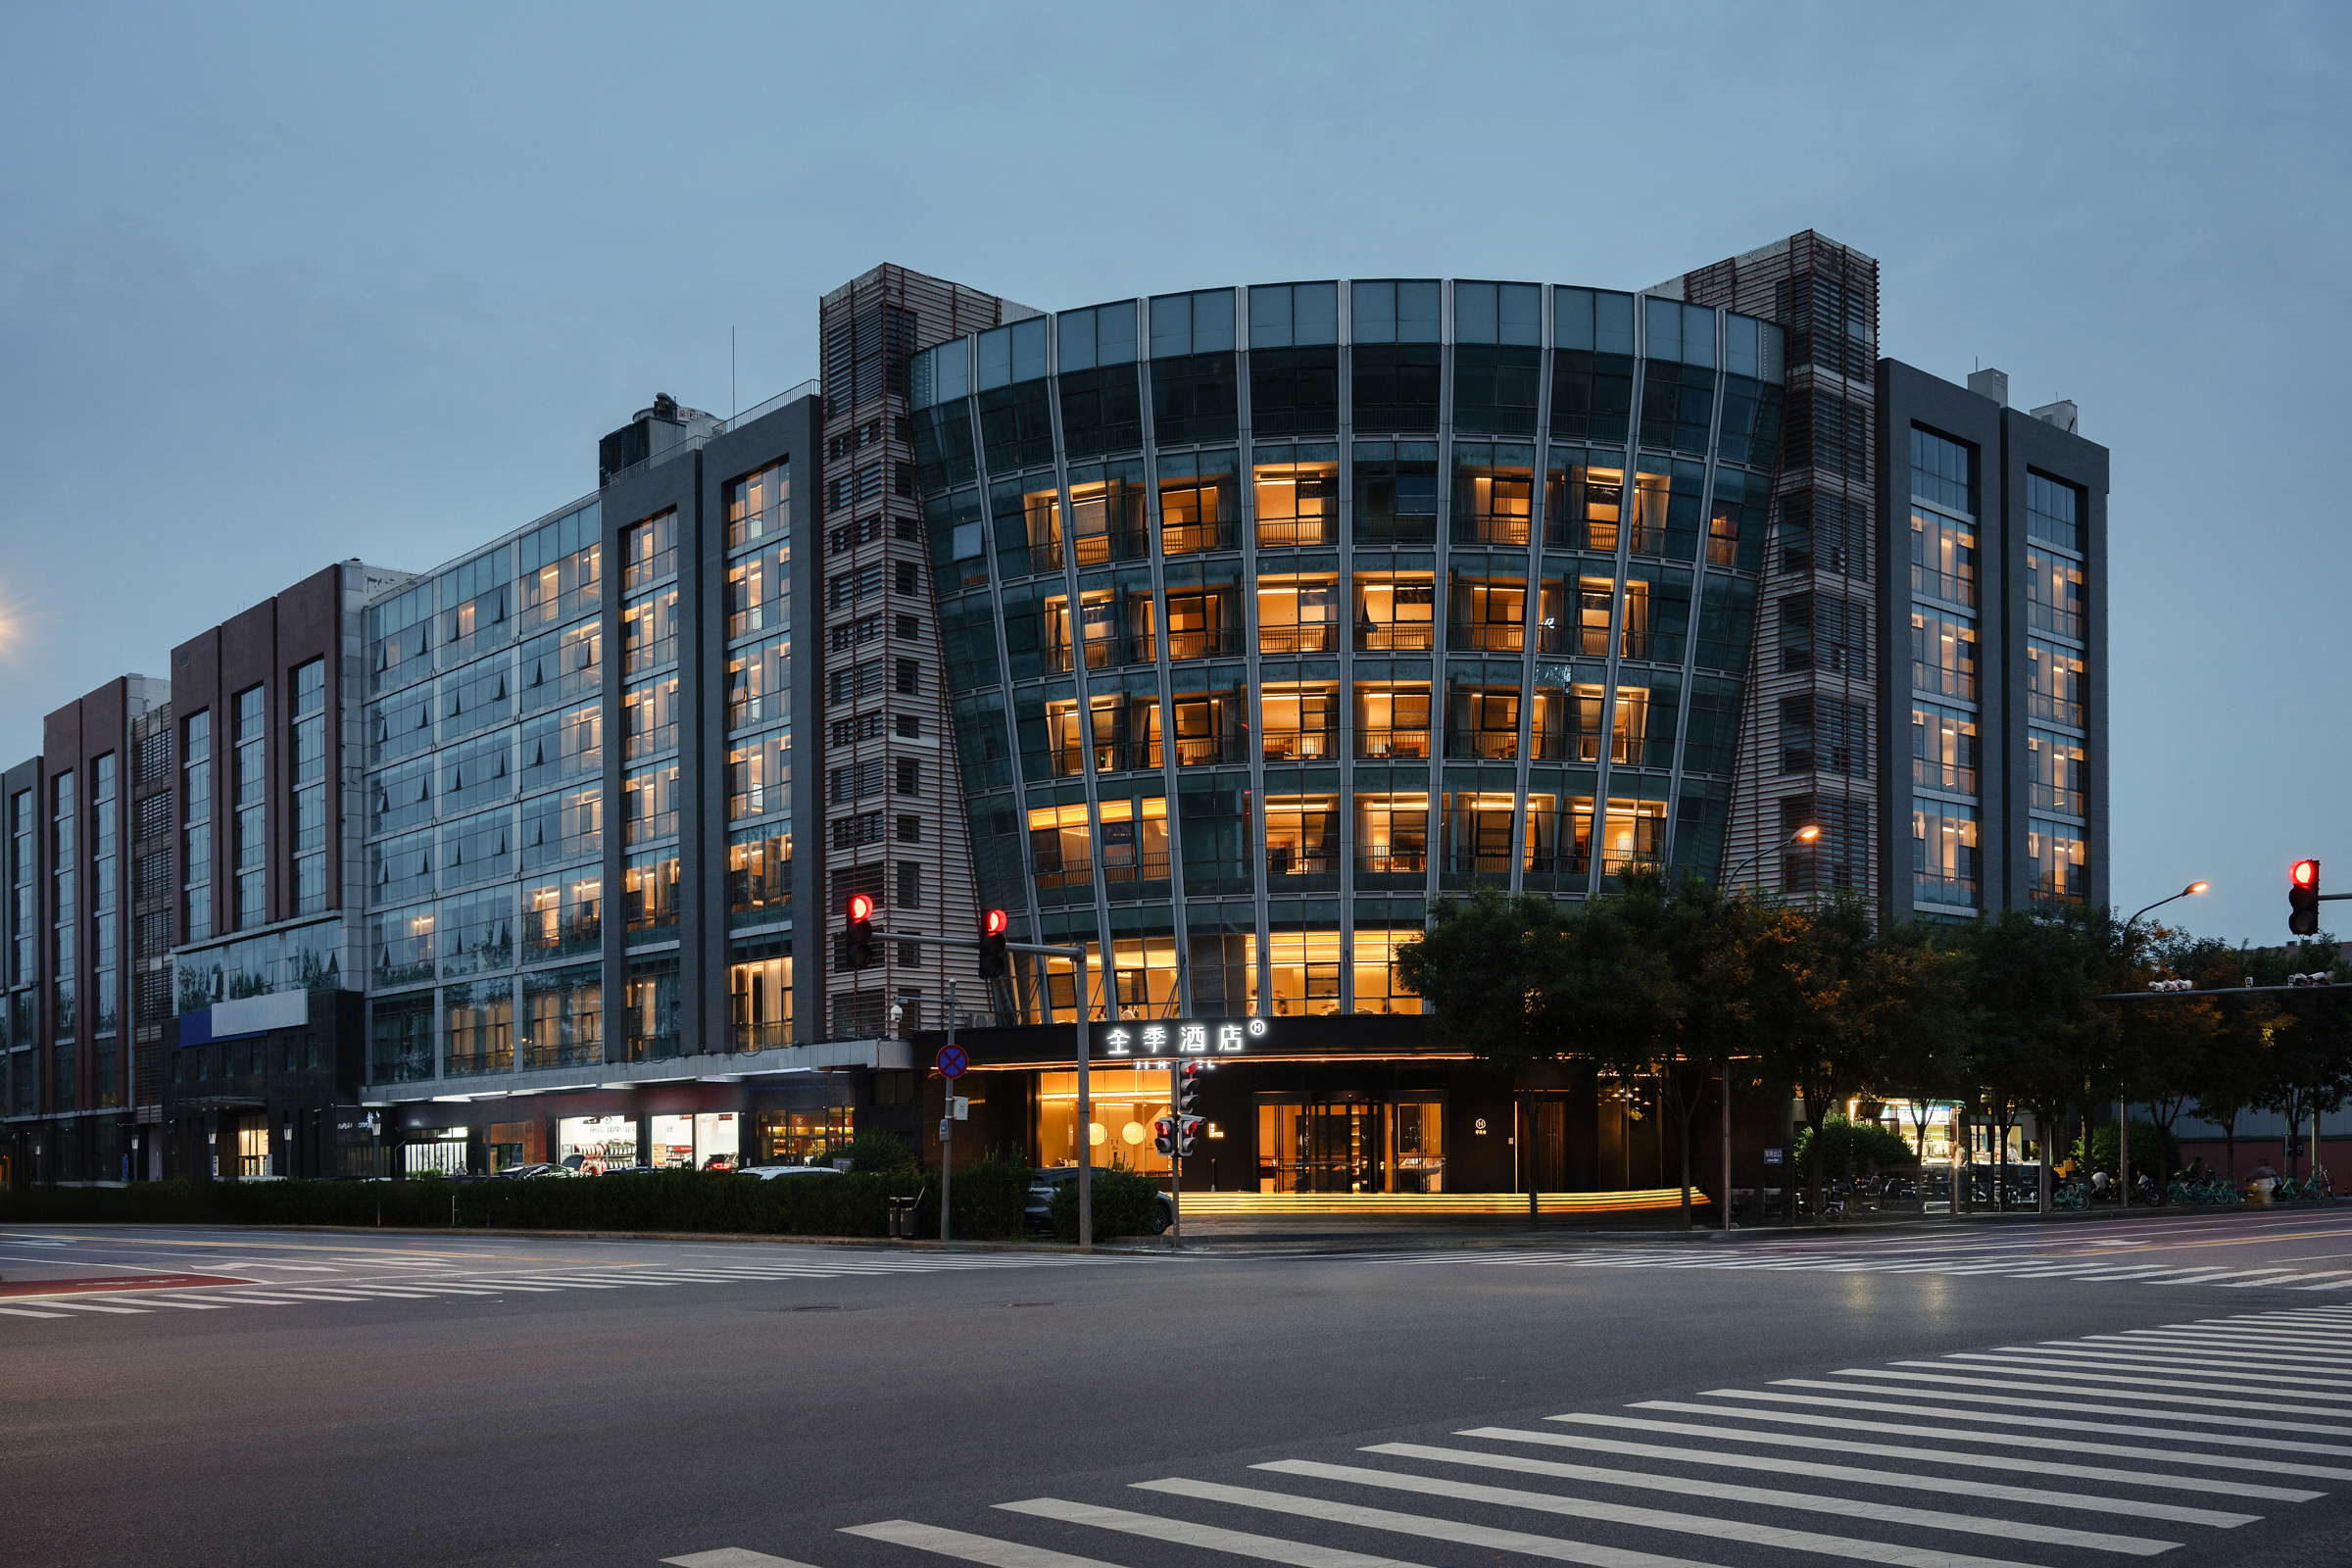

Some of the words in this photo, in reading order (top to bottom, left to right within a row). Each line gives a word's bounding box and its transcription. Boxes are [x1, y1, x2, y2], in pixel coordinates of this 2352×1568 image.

[1106, 1025, 1243, 1054] 全季酒店
[1136, 1060, 1149, 1070] JI
[1157, 1059, 1215, 1070] HEL
